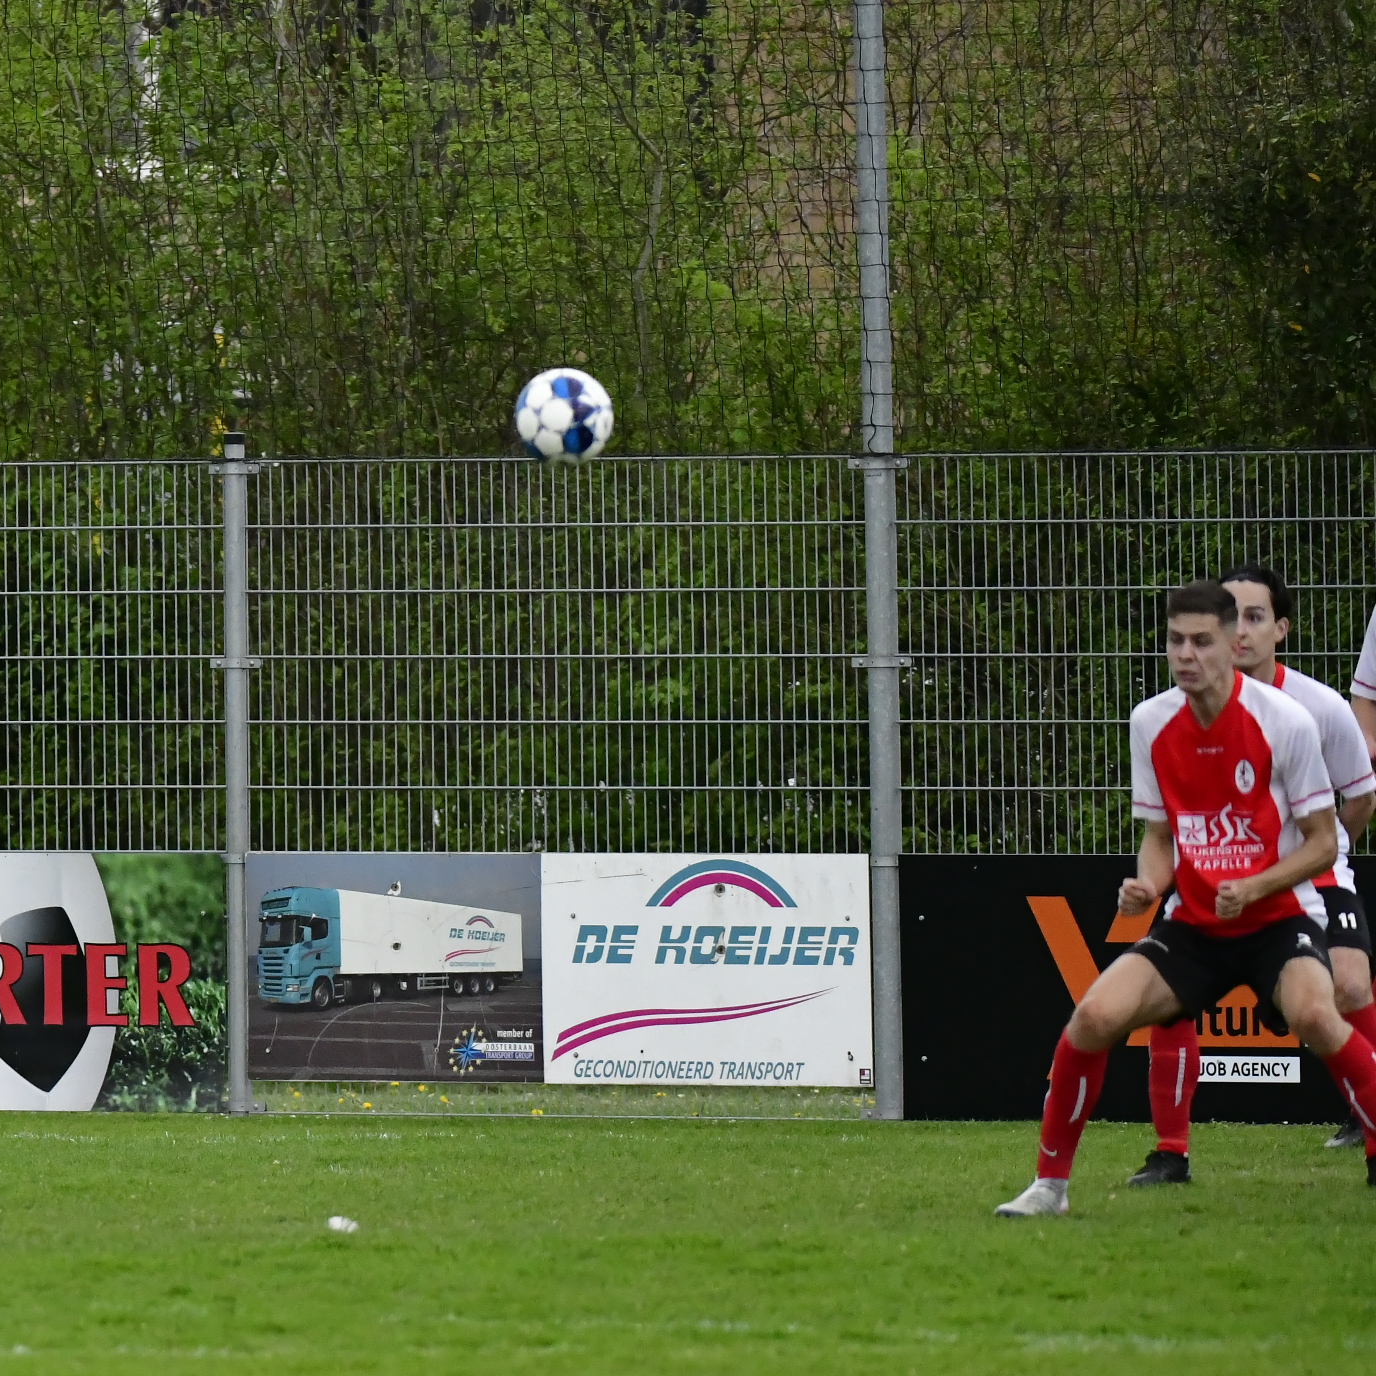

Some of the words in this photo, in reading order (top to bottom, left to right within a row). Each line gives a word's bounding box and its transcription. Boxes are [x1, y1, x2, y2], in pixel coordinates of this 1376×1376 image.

[1209, 802, 1261, 847] SSK
[1193, 857, 1251, 870] KAPELLE
[1338, 912, 1357, 930] 11
[449, 928, 464, 939] DE
[572, 925, 639, 964] DE
[655, 925, 860, 966] KOEIJER
[496, 1029, 524, 1038] member
[525, 1029, 533, 1038] of
[515, 1051, 533, 1060] GROUP
[573, 1059, 715, 1080] GECONDITIONEERD
[718, 1061, 806, 1081] TRANSPORT
[1231, 1062, 1290, 1077] AGENCY
